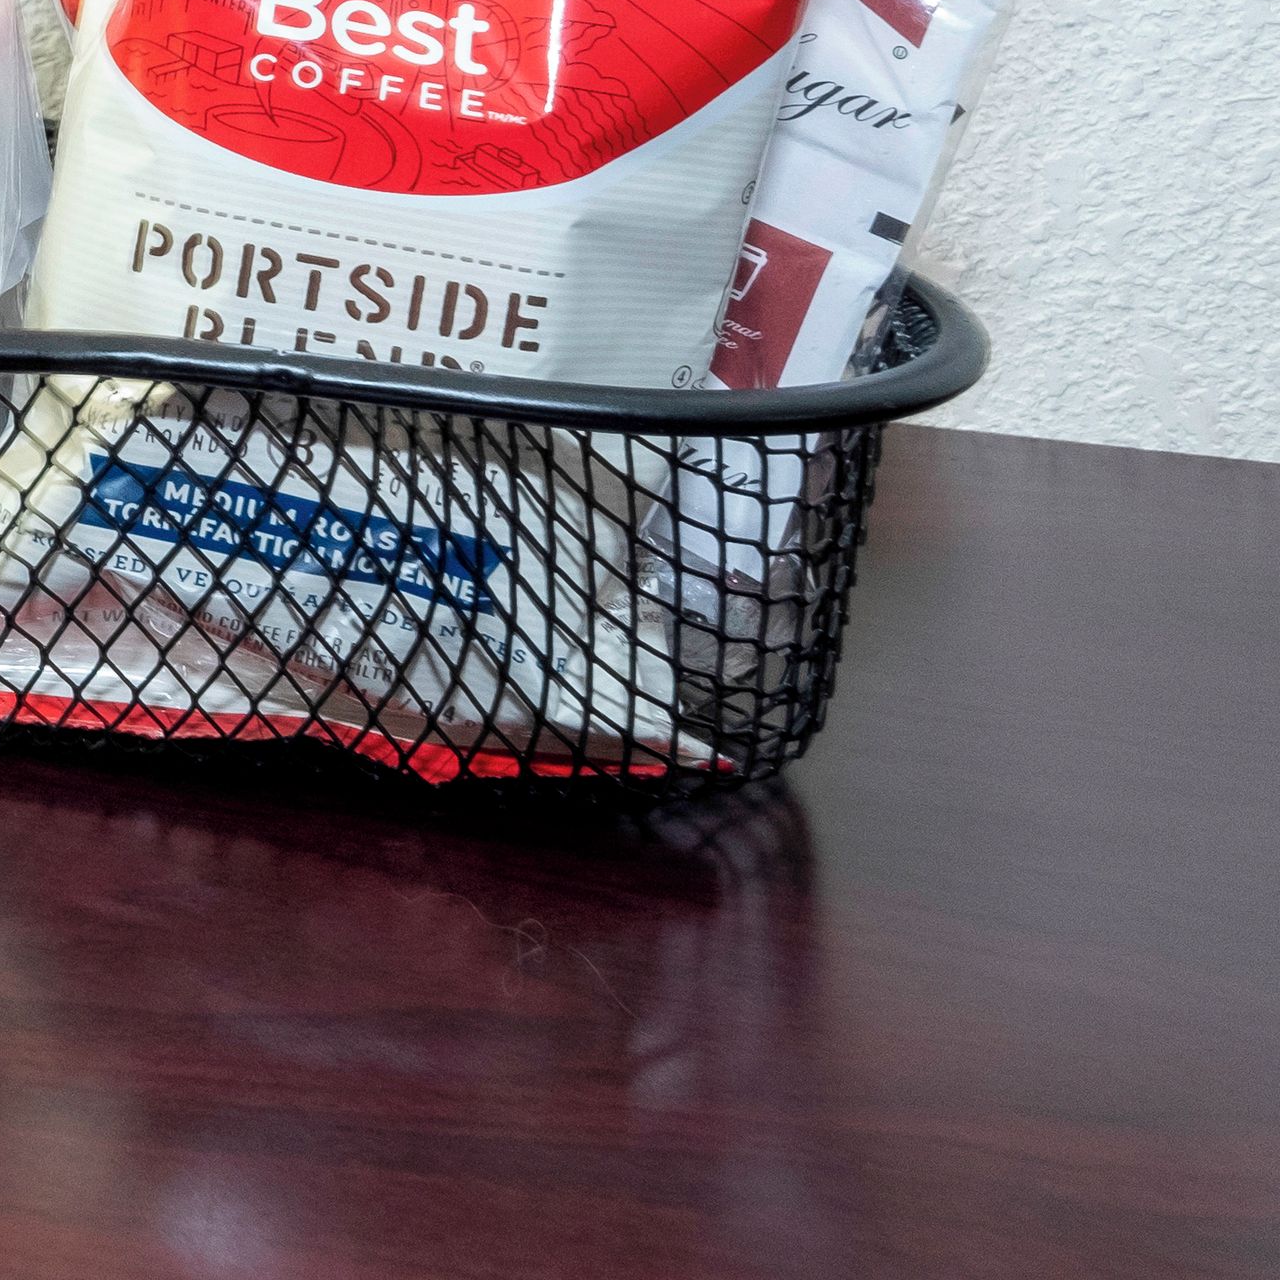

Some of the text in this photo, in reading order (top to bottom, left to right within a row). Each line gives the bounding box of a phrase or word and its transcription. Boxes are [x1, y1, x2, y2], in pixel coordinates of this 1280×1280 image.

[249, 52, 487, 119] COFFEE
[131, 218, 548, 353] PORTSIDE
[313, 515, 424, 552] ROAS
[439, 625, 527, 665] NTES
